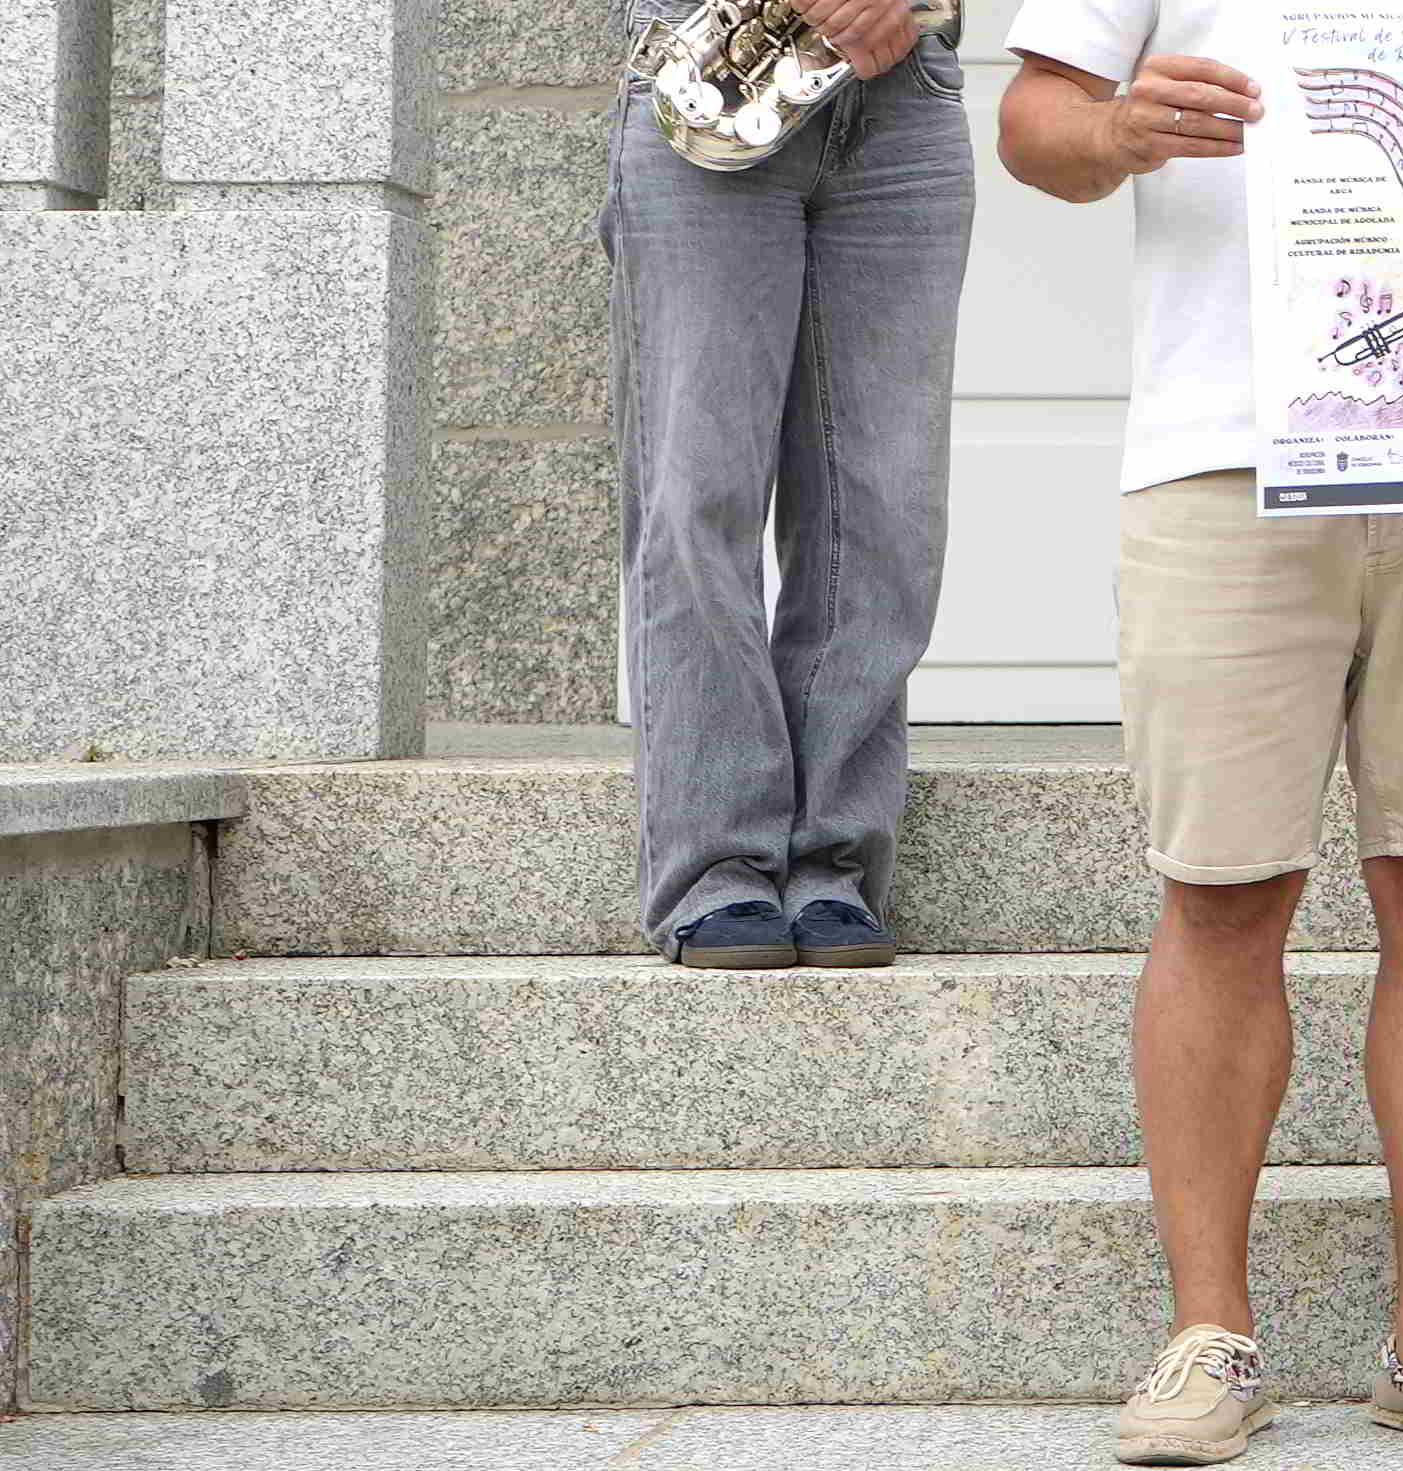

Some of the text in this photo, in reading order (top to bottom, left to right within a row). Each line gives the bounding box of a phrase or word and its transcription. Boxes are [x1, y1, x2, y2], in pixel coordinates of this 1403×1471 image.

[1301, 27, 1365, 44] Festival
[1374, 27, 1392, 44] de
[1368, 48, 1385, 63] de
